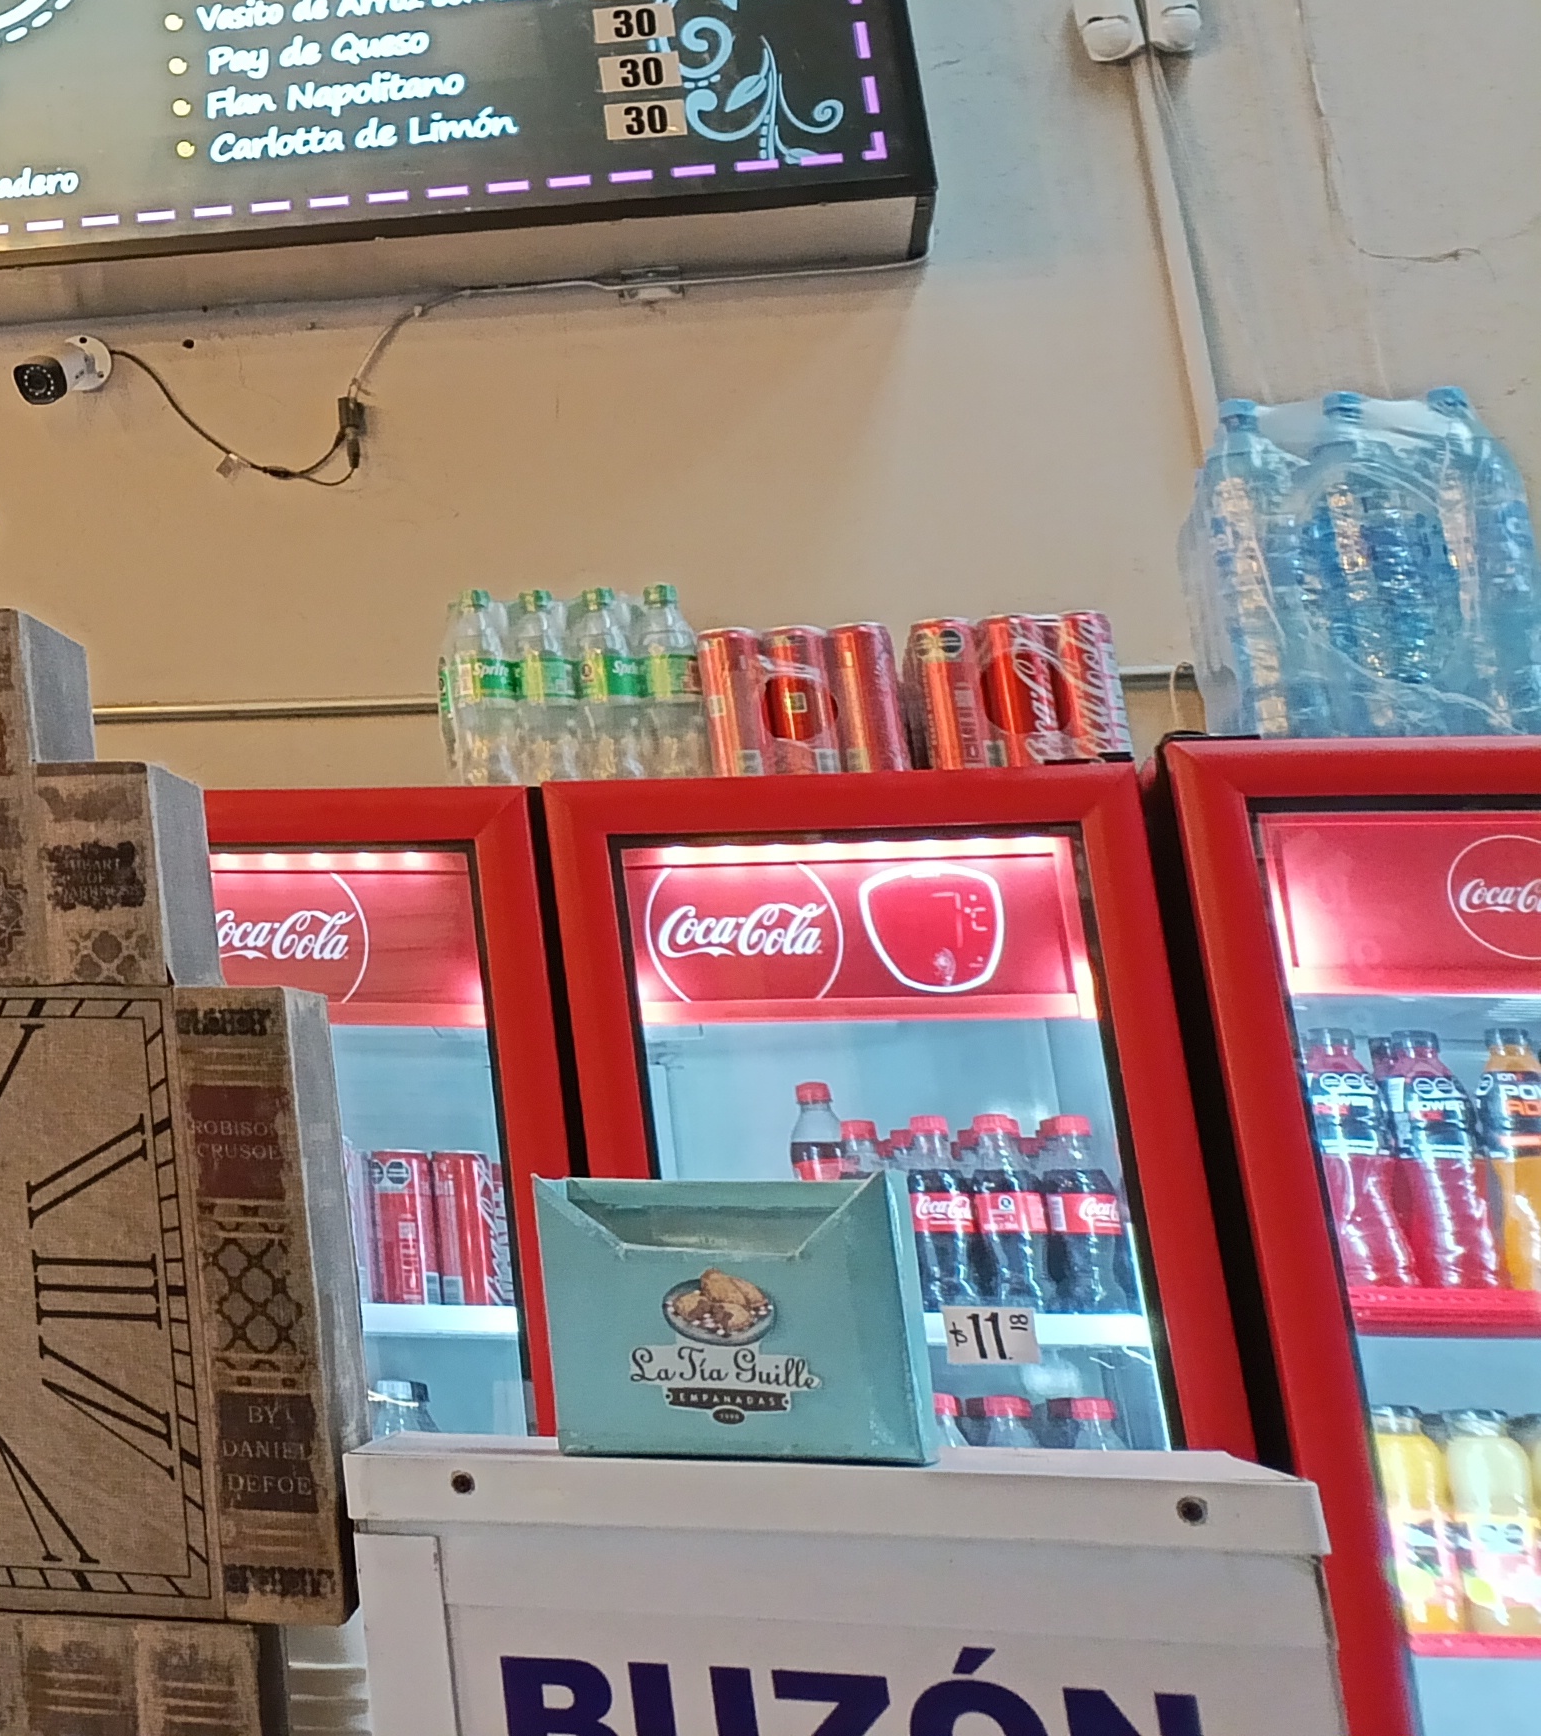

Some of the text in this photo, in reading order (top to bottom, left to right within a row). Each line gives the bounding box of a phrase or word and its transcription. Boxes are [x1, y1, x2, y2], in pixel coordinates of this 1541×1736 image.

[207, 8, 657, 79] Pay de Queso 30
[206, 56, 665, 120] Flan Napolitano 30
[209, 104, 669, 164] Carlotta de Limón 30
[658, 901, 828, 958] Coca-Cola
[630, 1346, 820, 1389] La Tía Guille
[680, 1392, 775, 1406] EMPANADAS
[227, 1475, 311, 1495] DEFOE
[499, 1647, 1201, 1736] BUZÓN
